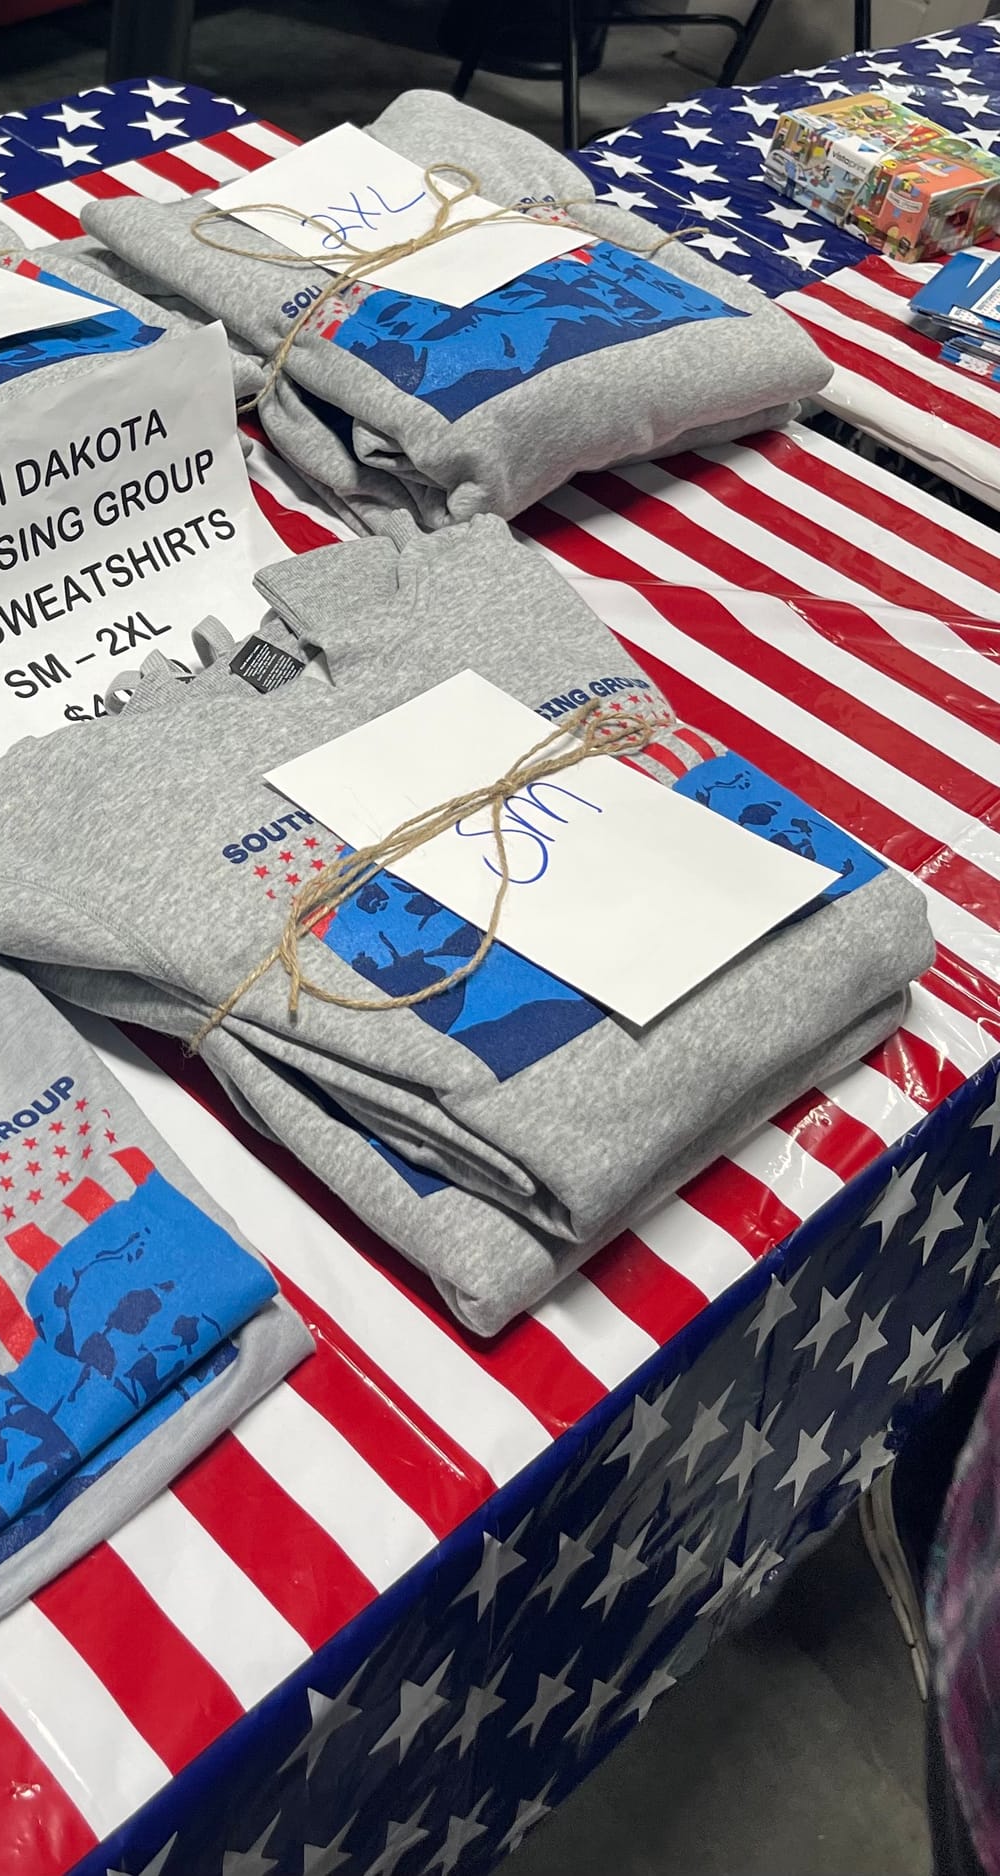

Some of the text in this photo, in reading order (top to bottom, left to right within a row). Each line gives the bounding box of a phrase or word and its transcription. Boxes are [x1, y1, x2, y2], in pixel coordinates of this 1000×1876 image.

[301, 185, 426, 250] 2XL
[281, 283, 340, 319] SOU
[16, 408, 169, 497] DAKOTA
[92, 449, 215, 527] GROUP
[3, 652, 73, 700] SM
[95, 611, 173, 657] 2XL
